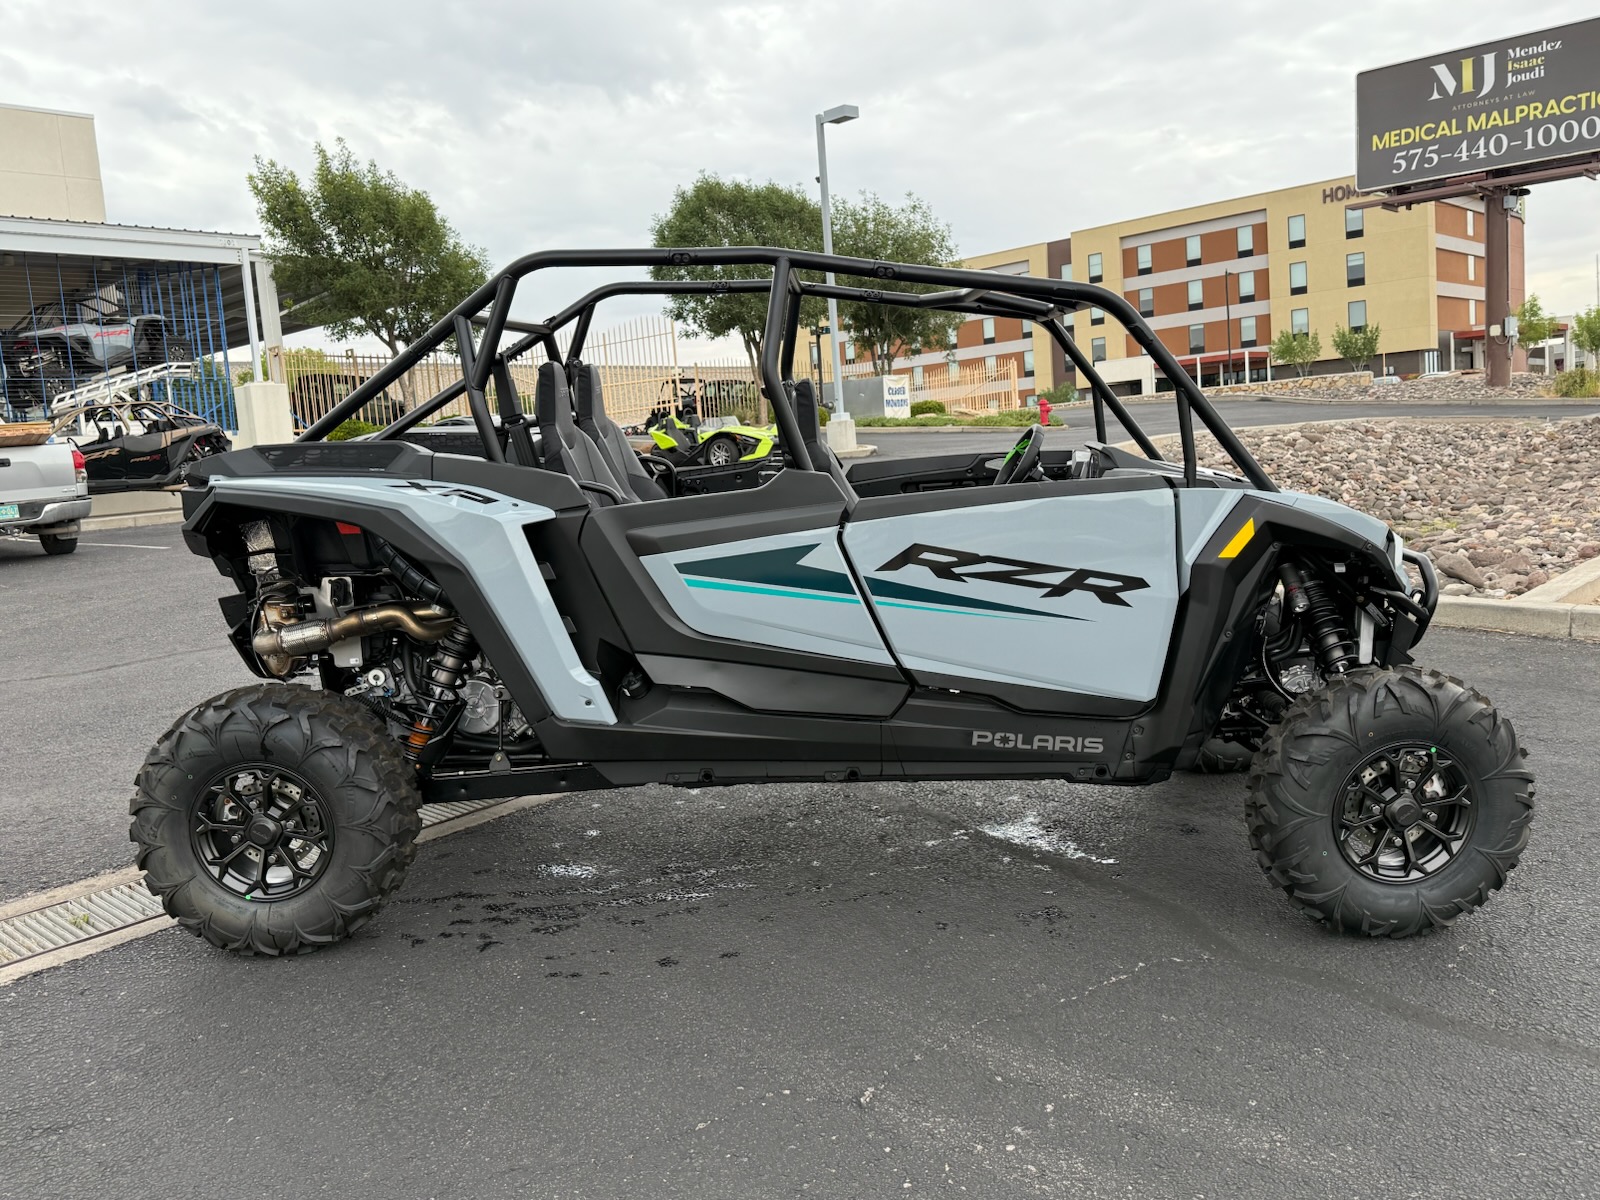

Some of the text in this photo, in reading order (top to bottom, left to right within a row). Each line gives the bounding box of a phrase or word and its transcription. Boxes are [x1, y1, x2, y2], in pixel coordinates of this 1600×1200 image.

[1507, 40, 1562, 60] Mendez
[1507, 55, 1545, 72] Isaac
[1427, 52, 1498, 101] MIJ
[1505, 66, 1545, 88] Joudi
[1452, 89, 1536, 111] ATTORNEYS AT LAW
[1372, 120, 1462, 151] MEDICAL
[1392, 115, 1600, 174] 575-440-1000
[1322, 184, 1371, 204] HOM
[874, 543, 1151, 608] RZR
[972, 731, 1104, 753] POLARIS
